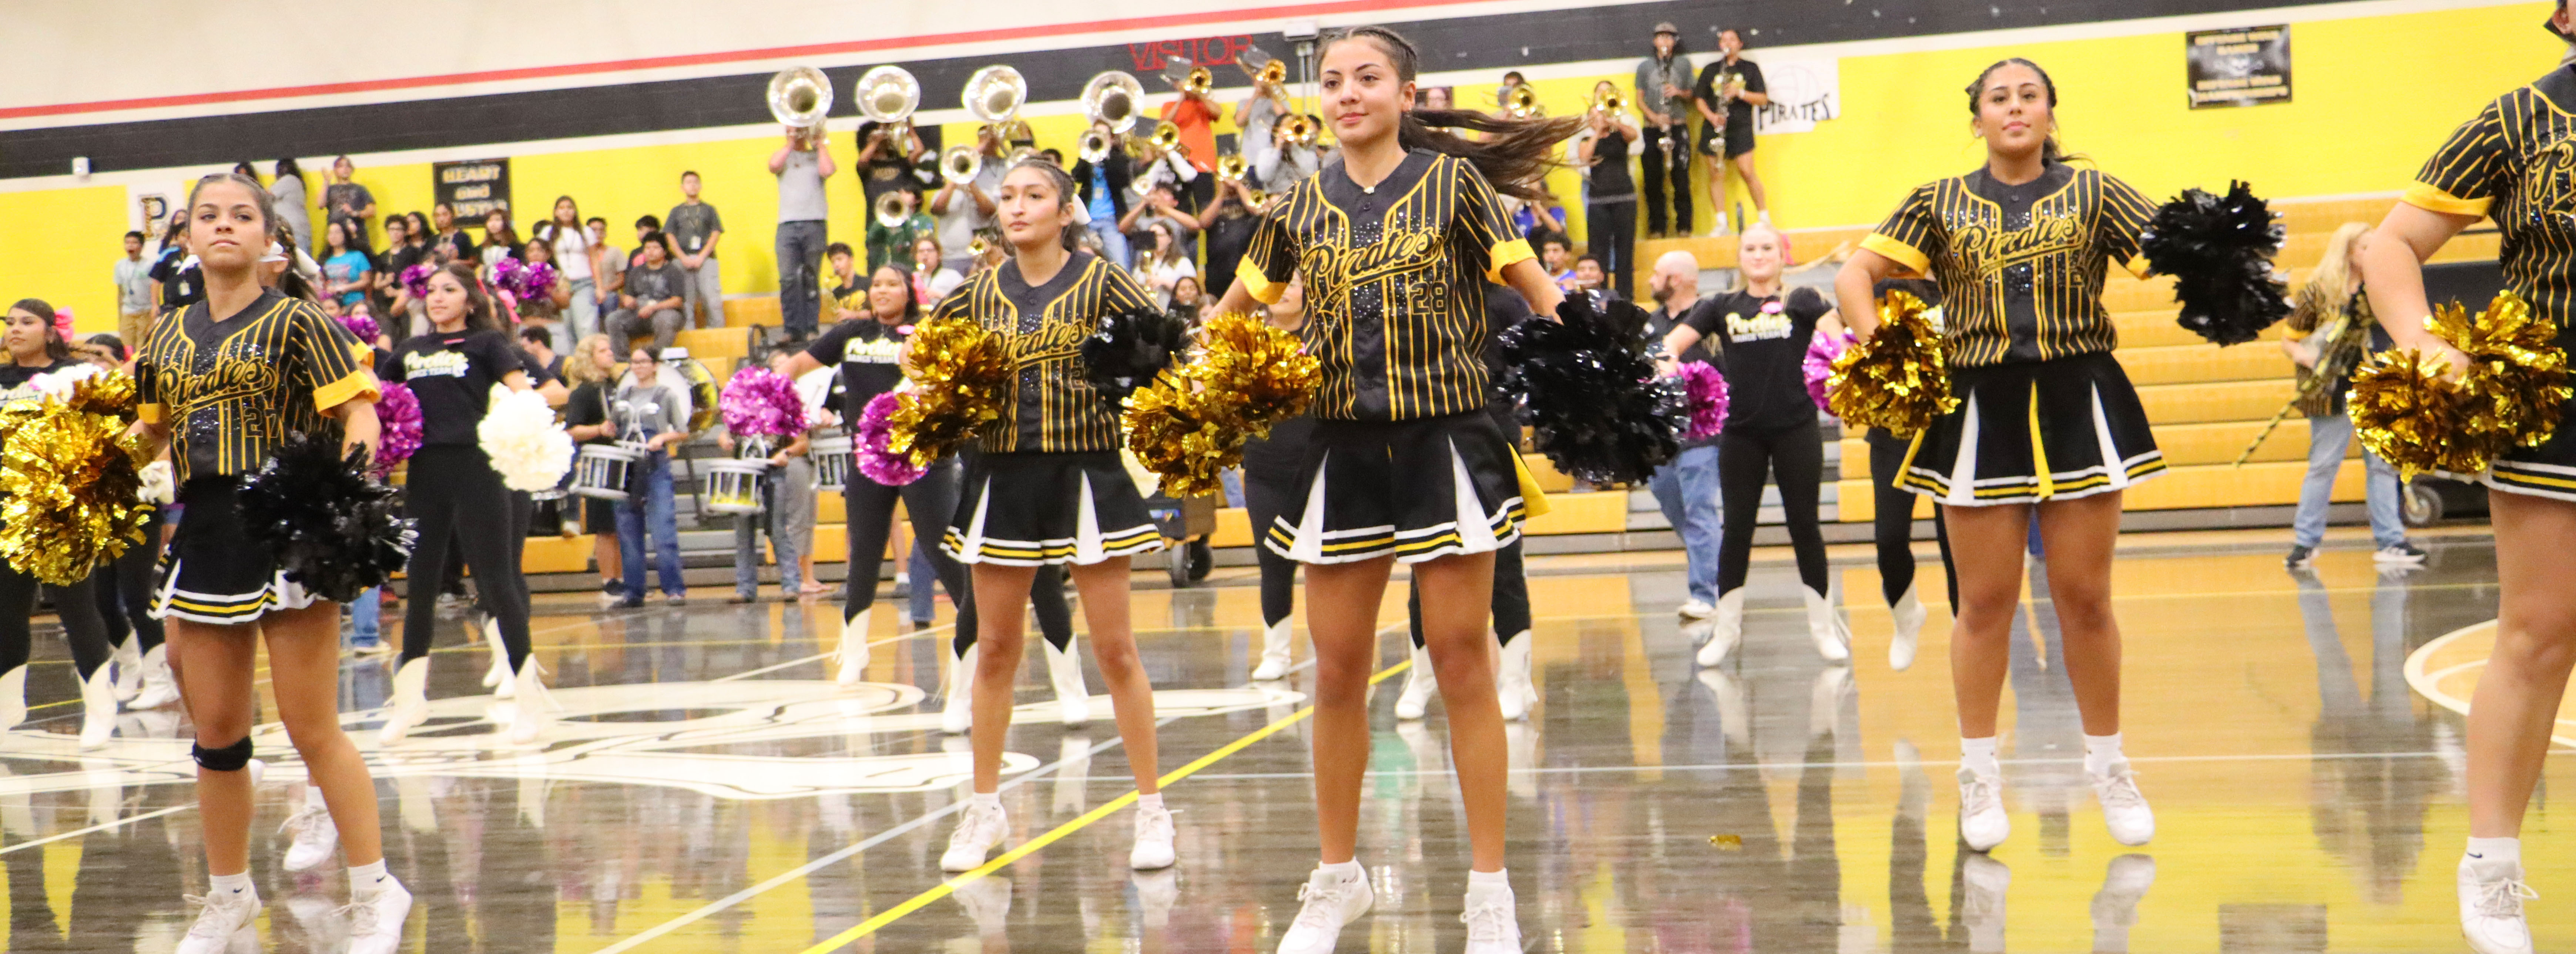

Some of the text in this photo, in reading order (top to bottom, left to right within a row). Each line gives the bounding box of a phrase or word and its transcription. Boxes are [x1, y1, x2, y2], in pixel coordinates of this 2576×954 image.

[1128, 34, 1254, 71] VISITOR
[1758, 93, 1830, 131] PIRATES
[442, 165, 500, 184] HEART
[1951, 214, 2087, 274] Pirates
[1301, 226, 1443, 303] Pirates
[1409, 282, 1448, 315] 28
[158, 356, 277, 408] Pirates
